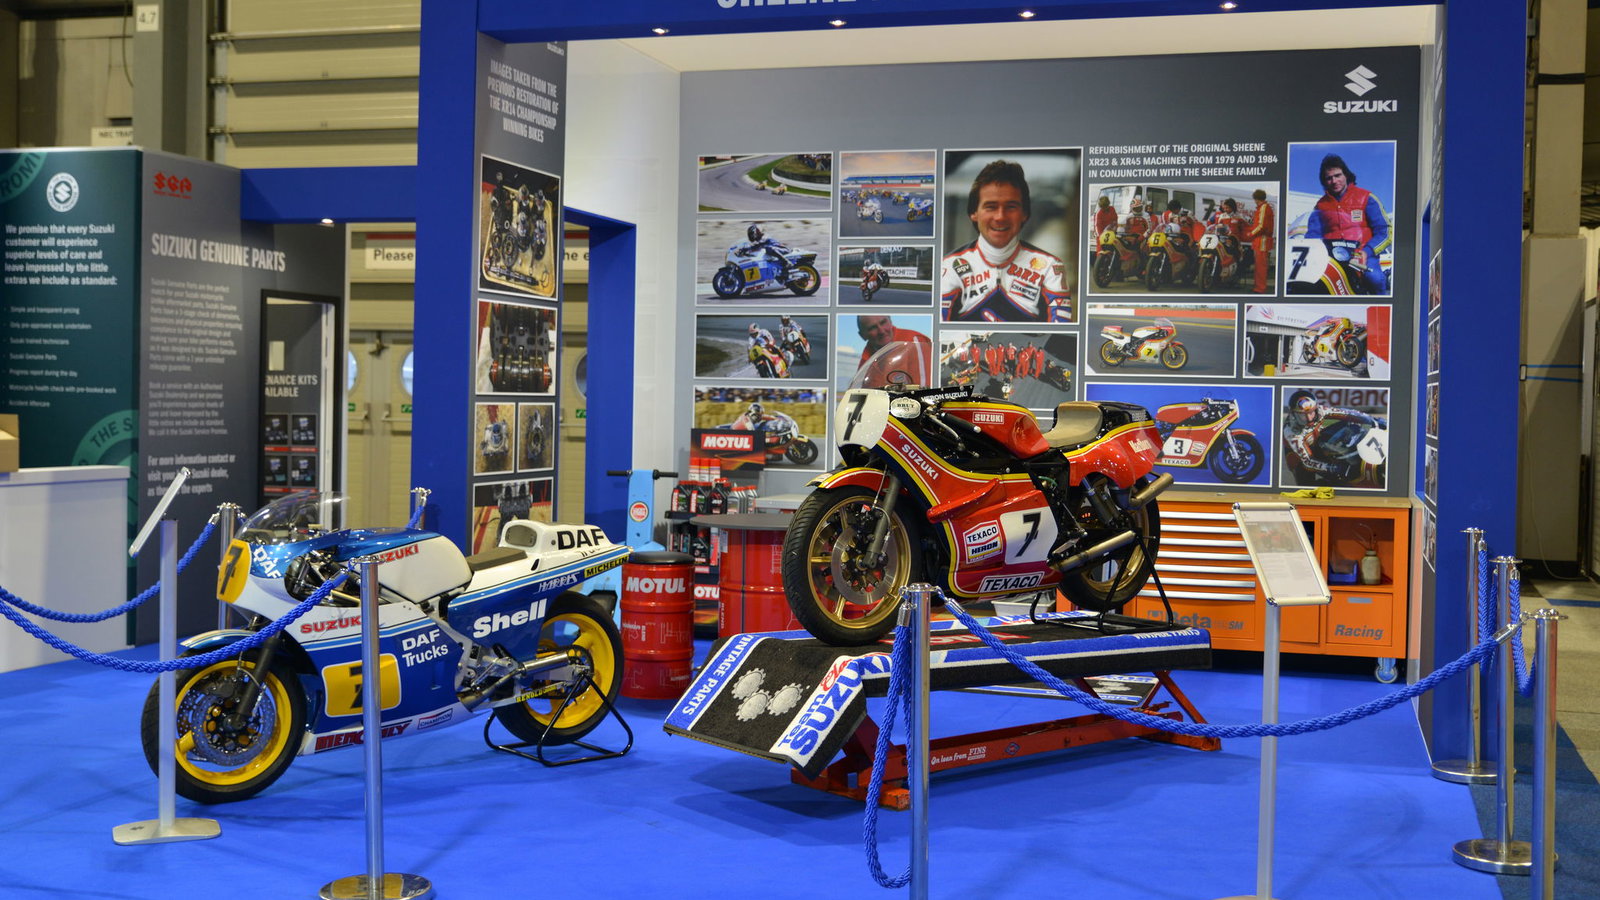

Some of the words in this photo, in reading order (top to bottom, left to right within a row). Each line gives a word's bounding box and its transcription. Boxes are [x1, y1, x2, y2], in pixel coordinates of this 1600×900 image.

[487, 75, 516, 98] PREVIOUS
[513, 68, 531, 88] TAKEN
[547, 81, 557, 98] THE
[489, 94, 501, 111] THE
[516, 104, 557, 130] CHAMPIONSHIP
[1323, 99, 1398, 114] SUZUKI
[502, 116, 528, 138] WINNING
[528, 126, 544, 143] BIKES
[1088, 145, 1158, 155] REFURBISHMENT
[1159, 145, 1171, 153] OF
[1173, 144, 1189, 153] THE
[1190, 143, 1231, 153] ORIGINAL
[1232, 143, 1266, 152] SHEENE
[1088, 157, 1110, 166] XR23
[1111, 157, 1118, 166] &
[1119, 157, 1142, 166] XR45
[1143, 156, 1187, 165] MACHINES
[1188, 155, 1214, 165] FROM
[1215, 155, 1235, 164] 1979
[1236, 155, 1256, 164] AND
[1257, 154, 1279, 164] 1984
[1088, 169, 1098, 178] IN
[1099, 168, 1158, 178] CONJUNCTION
[1159, 168, 1181, 177] WITH
[1183, 167, 1200, 176] THE
[1201, 167, 1234, 176] SHEENE
[1235, 166, 1267, 176] FAMILY
[5, 225, 17, 233] We
[18, 224, 49, 235] promise
[50, 224, 66, 234] that
[67, 225, 88, 235] every
[89, 223, 115, 233] Suzuki
[5, 237, 40, 247] customer
[41, 237, 56, 247] will
[56, 237, 98, 248] experience
[1205, 237, 1213, 248] 7
[5, 250, 36, 260] superior
[37, 250, 59, 260] levels
[60, 250, 69, 259] of
[70, 251, 87, 260] care
[88, 250, 103, 260] and
[151, 233, 197, 260] SUZUKI
[200, 240, 250, 267] GENUINE
[251, 247, 286, 272] PARTS
[373, 248, 414, 261] Please
[4, 263, 24, 272] leave
[25, 263, 64, 273] impressed
[65, 263, 75, 274] by
[76, 263, 89, 272] the
[90, 263, 109, 272] little
[1287, 246, 1311, 280] 7
[4, 276, 28, 285] extras
[29, 277, 40, 285] we
[41, 276, 69, 285] include
[70, 277, 81, 285] as
[962, 269, 991, 288] ERON
[1052, 265, 1068, 290] 7
[297, 374, 318, 385] KITS
[944, 391, 968, 400] SUZUKI
[843, 393, 869, 441] 7
[974, 413, 1003, 423] SUZUKI
[90, 420, 120, 448] THE
[703, 436, 751, 448] MOTUL
[1174, 439, 1183, 454] 3
[1366, 436, 1385, 458] 7
[901, 443, 939, 480] SUZUKI
[556, 528, 605, 550] DAF
[966, 526, 998, 543] TEXACO
[1014, 511, 1042, 558] 7
[970, 541, 999, 555] HERON
[219, 545, 245, 595] 7
[253, 545, 283, 579] DAF
[585, 555, 629, 578] MICHELIN
[625, 576, 686, 594] MOTUL
[693, 586, 720, 599] OTU
[983, 575, 1040, 592] TEXACO
[301, 615, 362, 633] SUZUK
[472, 598, 548, 639] Shell
[401, 628, 440, 651] DAF
[1334, 624, 1384, 641] Racing
[401, 644, 449, 668] Trucks
[713, 633, 757, 678] VINTAGE
[682, 679, 718, 716] PARTS
[790, 655, 894, 756] SUZUKI
[420, 713, 452, 728] CHAMPION
[967, 746, 987, 756] FINS
